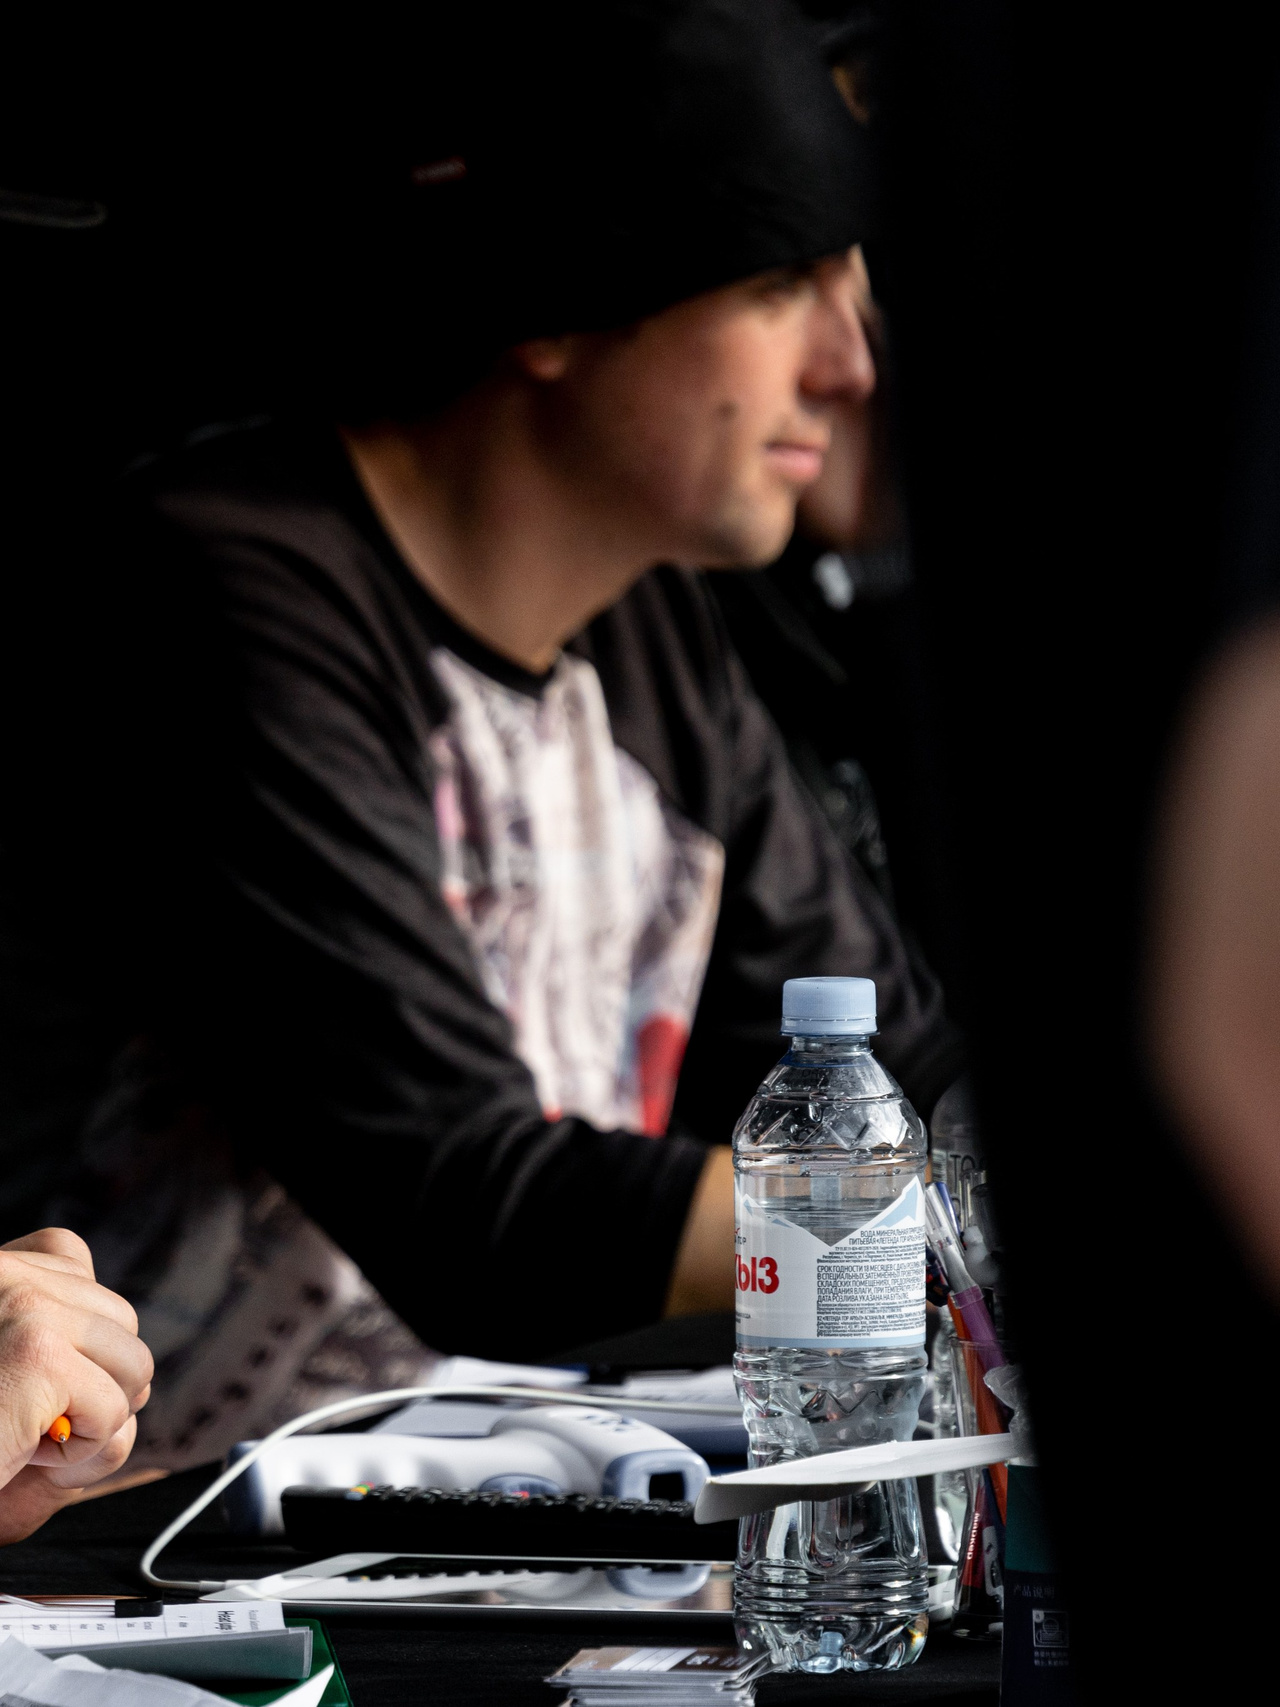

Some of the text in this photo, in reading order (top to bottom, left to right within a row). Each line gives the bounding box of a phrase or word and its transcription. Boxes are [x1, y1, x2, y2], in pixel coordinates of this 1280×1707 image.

[817, 1265, 832, 1273] СРОК
[833, 1265, 863, 1273] ГОДНОСТИ
[870, 1263, 893, 1272] МЕСЯЦЕВ
[821, 1272, 864, 1281] СПЕЦИАЛЬНЫХ
[817, 1279, 852, 1288] СКЛАДСКИХ
[817, 1287, 854, 1295] ПОПАДАНИЯ
[817, 1295, 832, 1303] ДАТА
[833, 1294, 858, 1302] РОЗЛИВА
